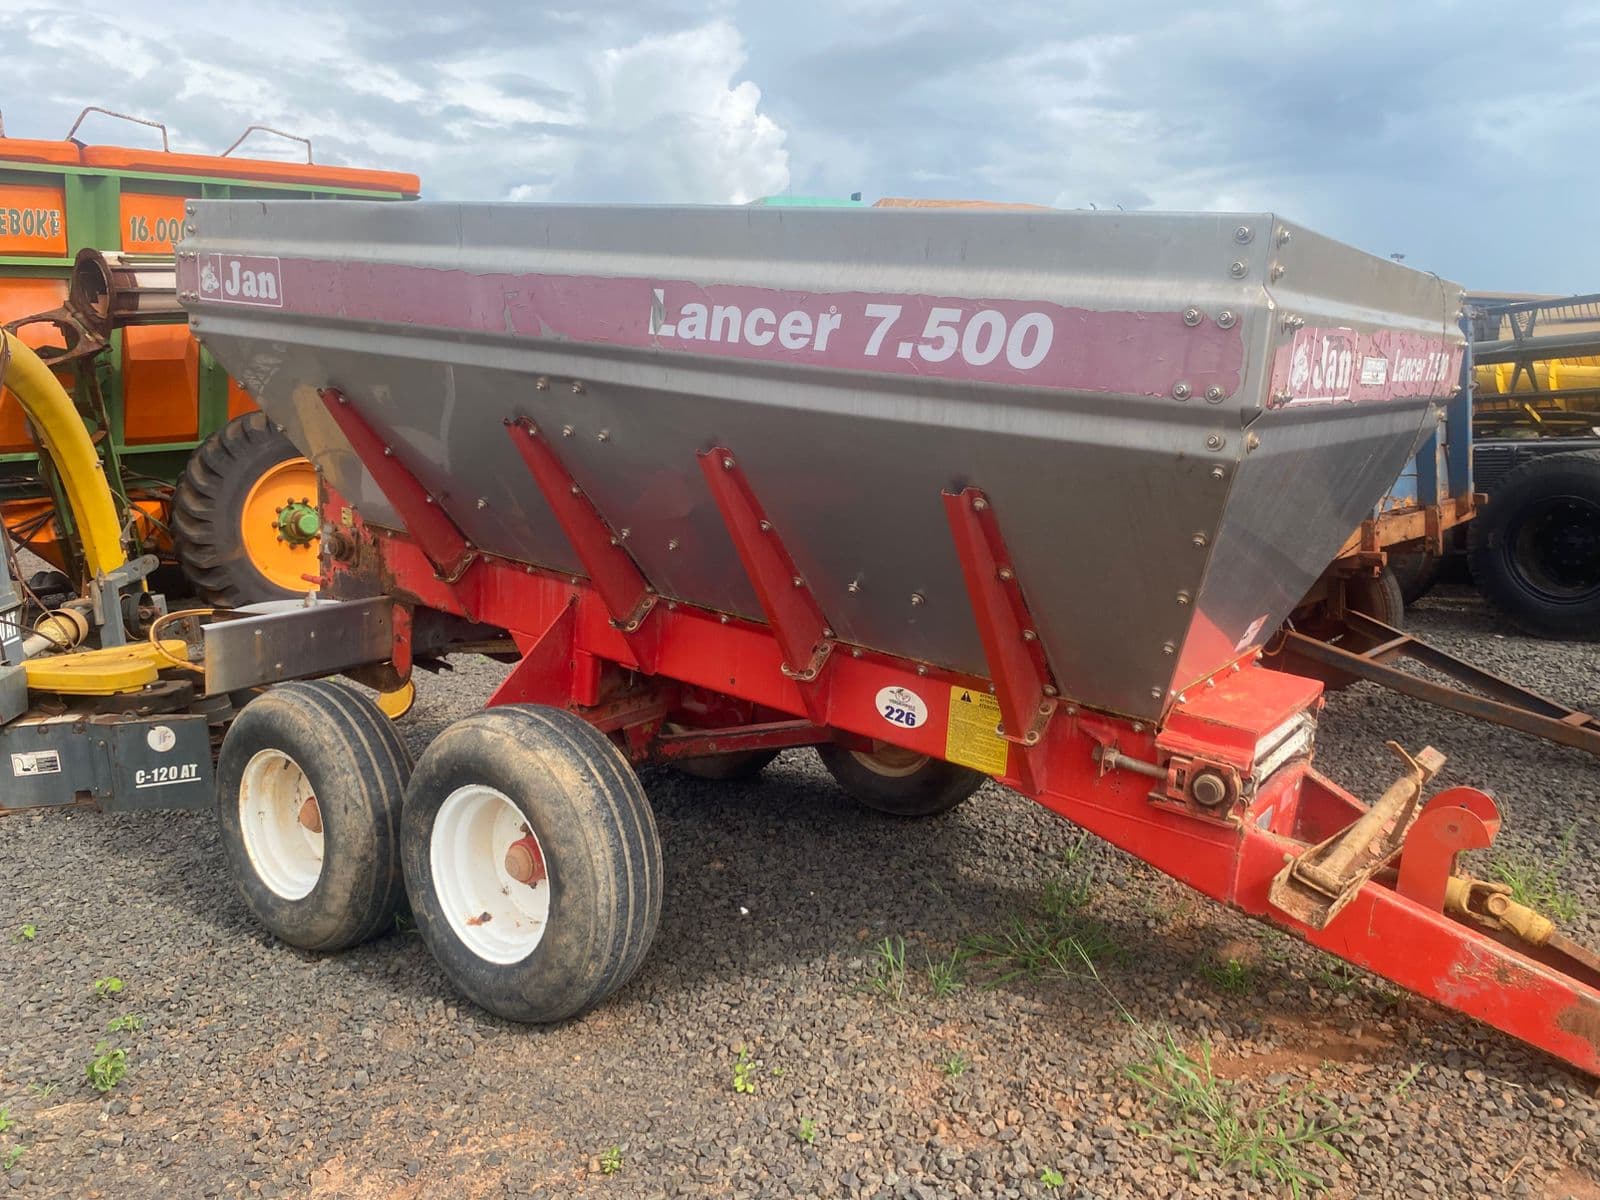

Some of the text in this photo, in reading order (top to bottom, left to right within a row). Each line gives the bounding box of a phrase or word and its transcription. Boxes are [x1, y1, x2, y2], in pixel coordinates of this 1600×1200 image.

[225, 261, 278, 300] Jan
[648, 288, 1054, 370] Lancer 7.500
[1392, 348, 1426, 382] Lancer
[884, 705, 917, 727] 226
[135, 763, 198, 785] C-120 AT
